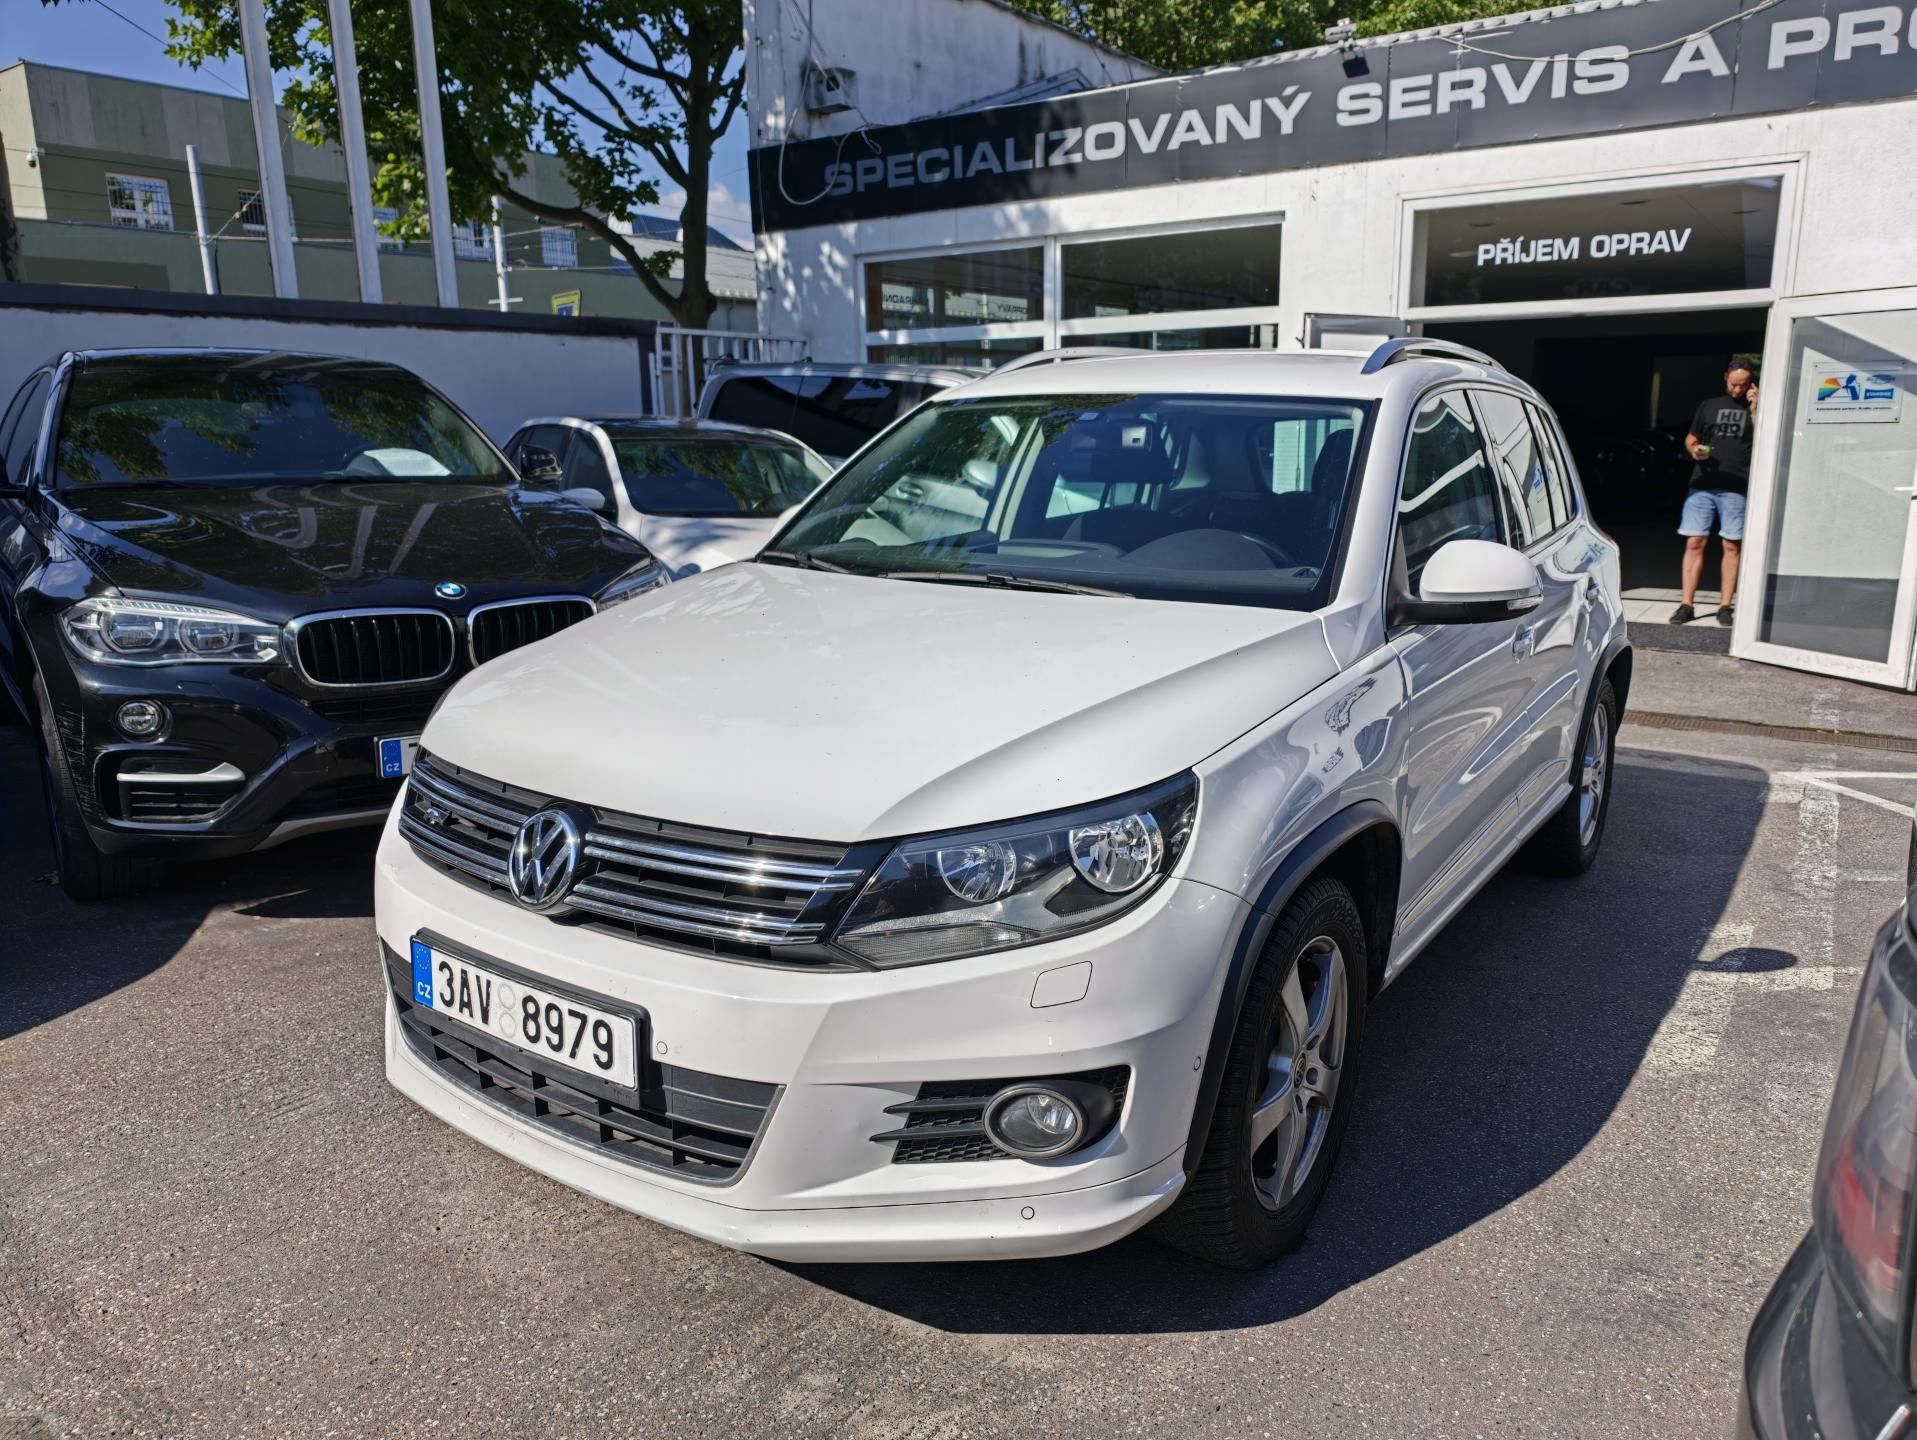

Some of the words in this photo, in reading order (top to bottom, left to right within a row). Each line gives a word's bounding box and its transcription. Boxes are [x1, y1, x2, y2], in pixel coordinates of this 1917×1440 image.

[824, 85, 1312, 197] SPECIALIZOVANÝ
[1336, 44, 1630, 127] SERVIS
[1660, 32, 1730, 83] A
[1767, 5, 1917, 70] PR
[1477, 236, 1580, 266] PŘÍJEM
[1590, 228, 1692, 258] OPRAV
[1720, 411, 1744, 422] HU
[385, 762, 400, 772] CZ
[417, 981, 431, 999] CZ
[438, 960, 491, 1025] 3AV
[522, 994, 613, 1070] 8979
